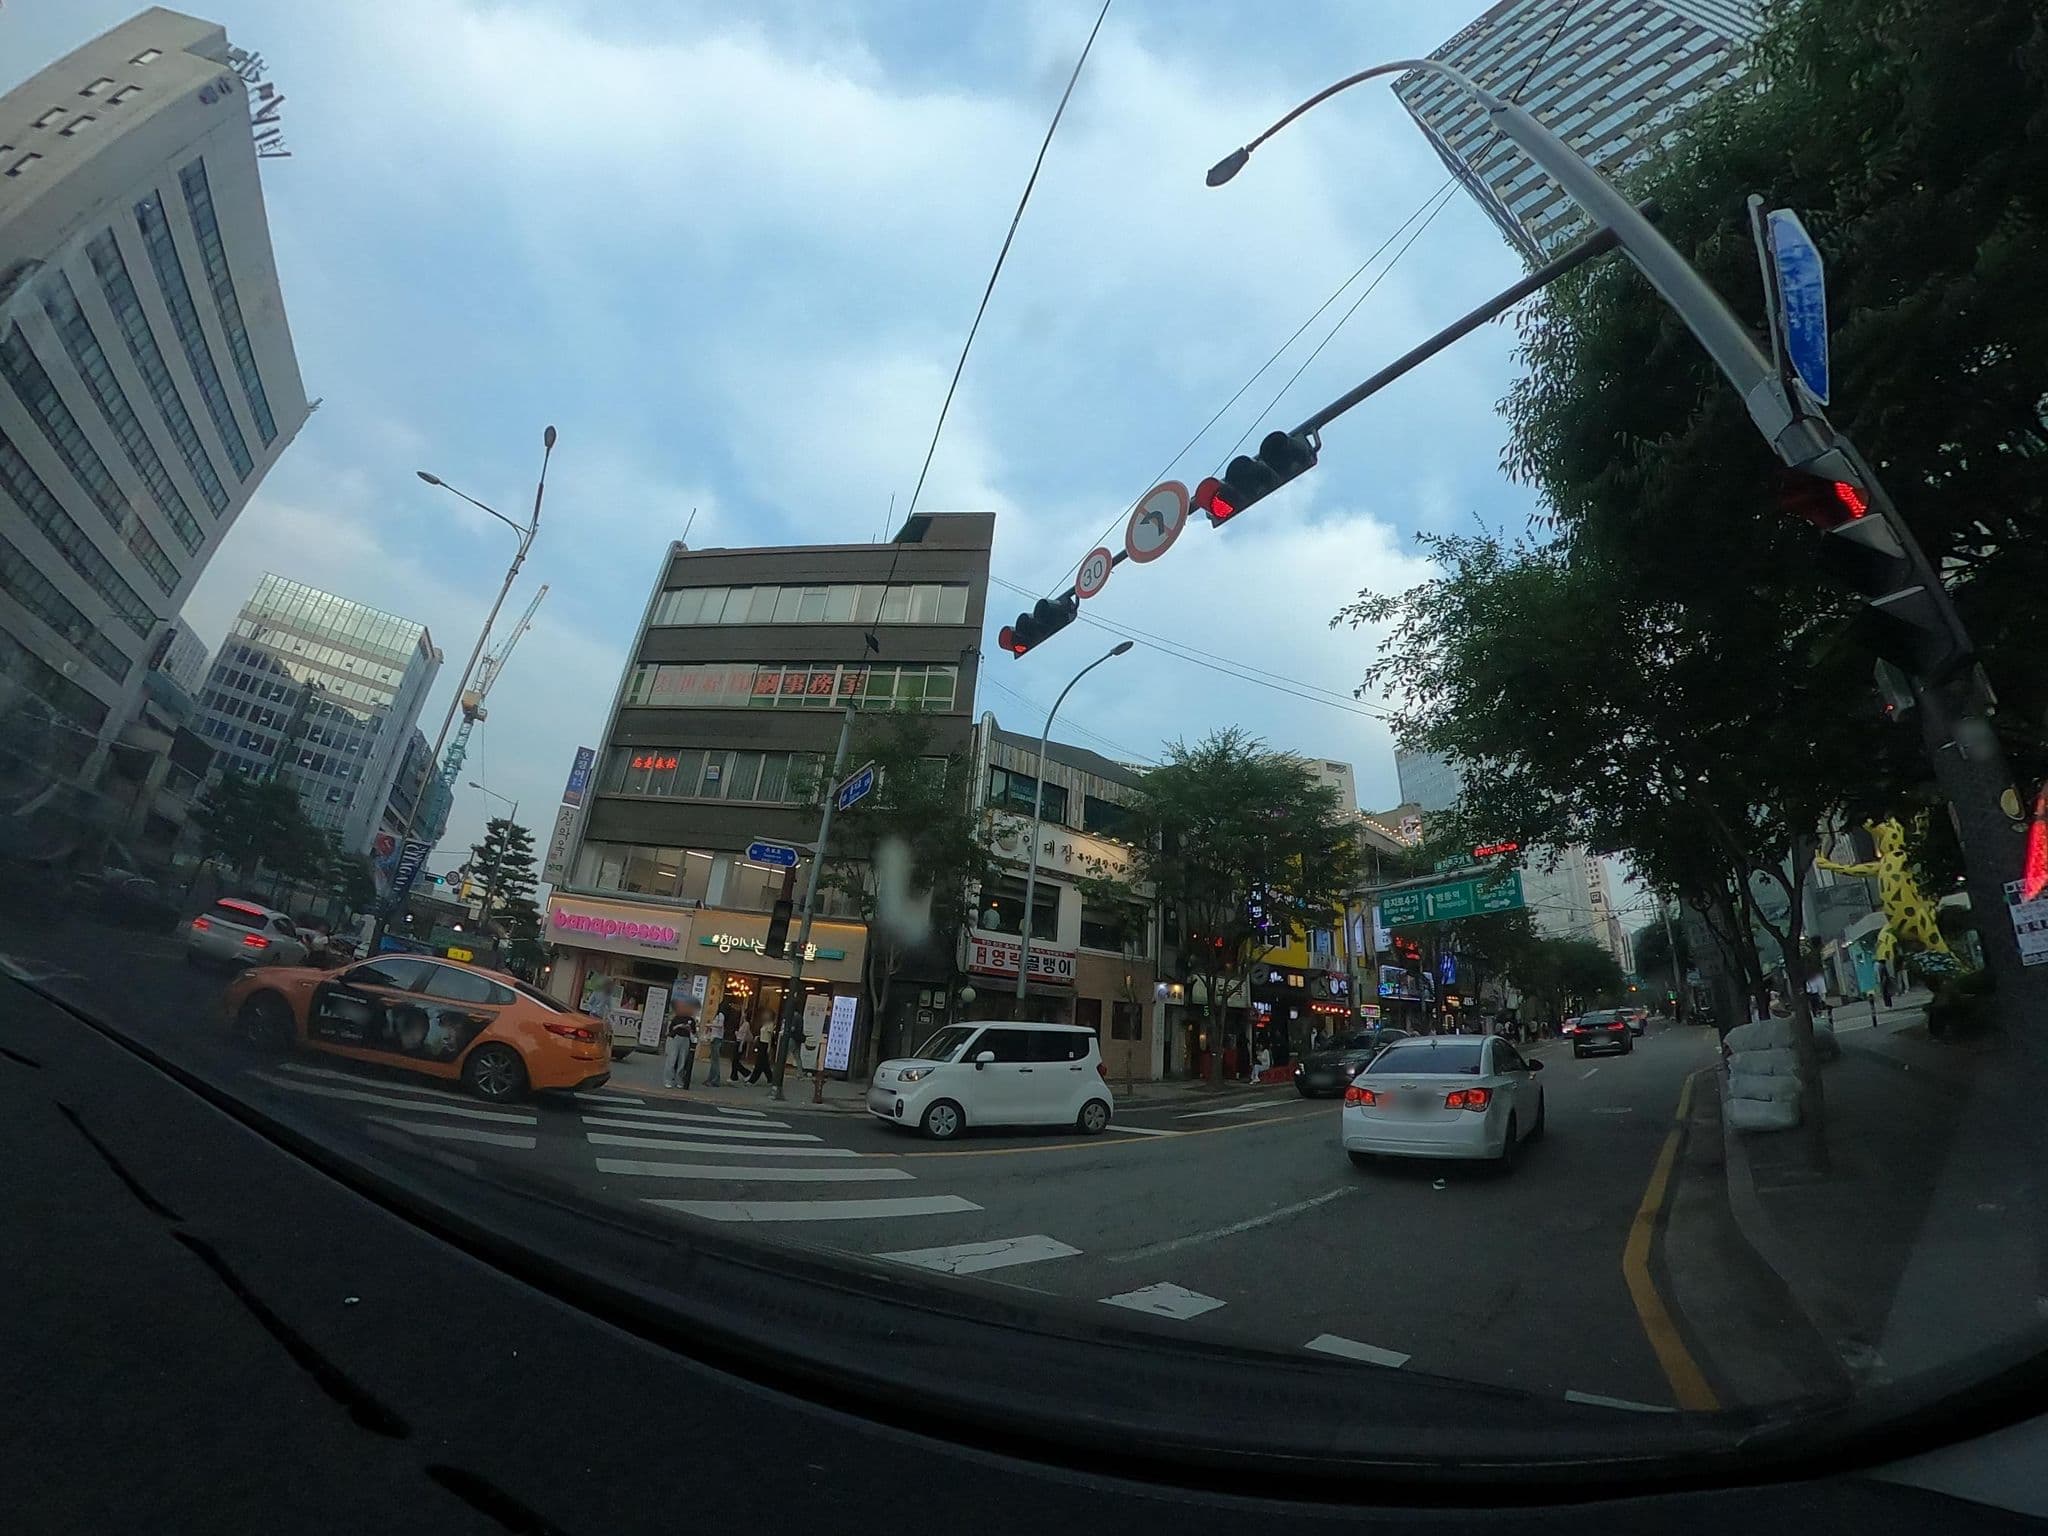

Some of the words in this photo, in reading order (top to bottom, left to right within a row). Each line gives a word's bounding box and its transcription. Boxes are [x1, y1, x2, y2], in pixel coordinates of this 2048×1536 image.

[1083, 560, 1103, 587] 30
[1383, 894, 1419, 909] 을지로4가
[1435, 889, 1460, 903] 명동역
[991, 949, 1072, 977] 영락골뱅이
